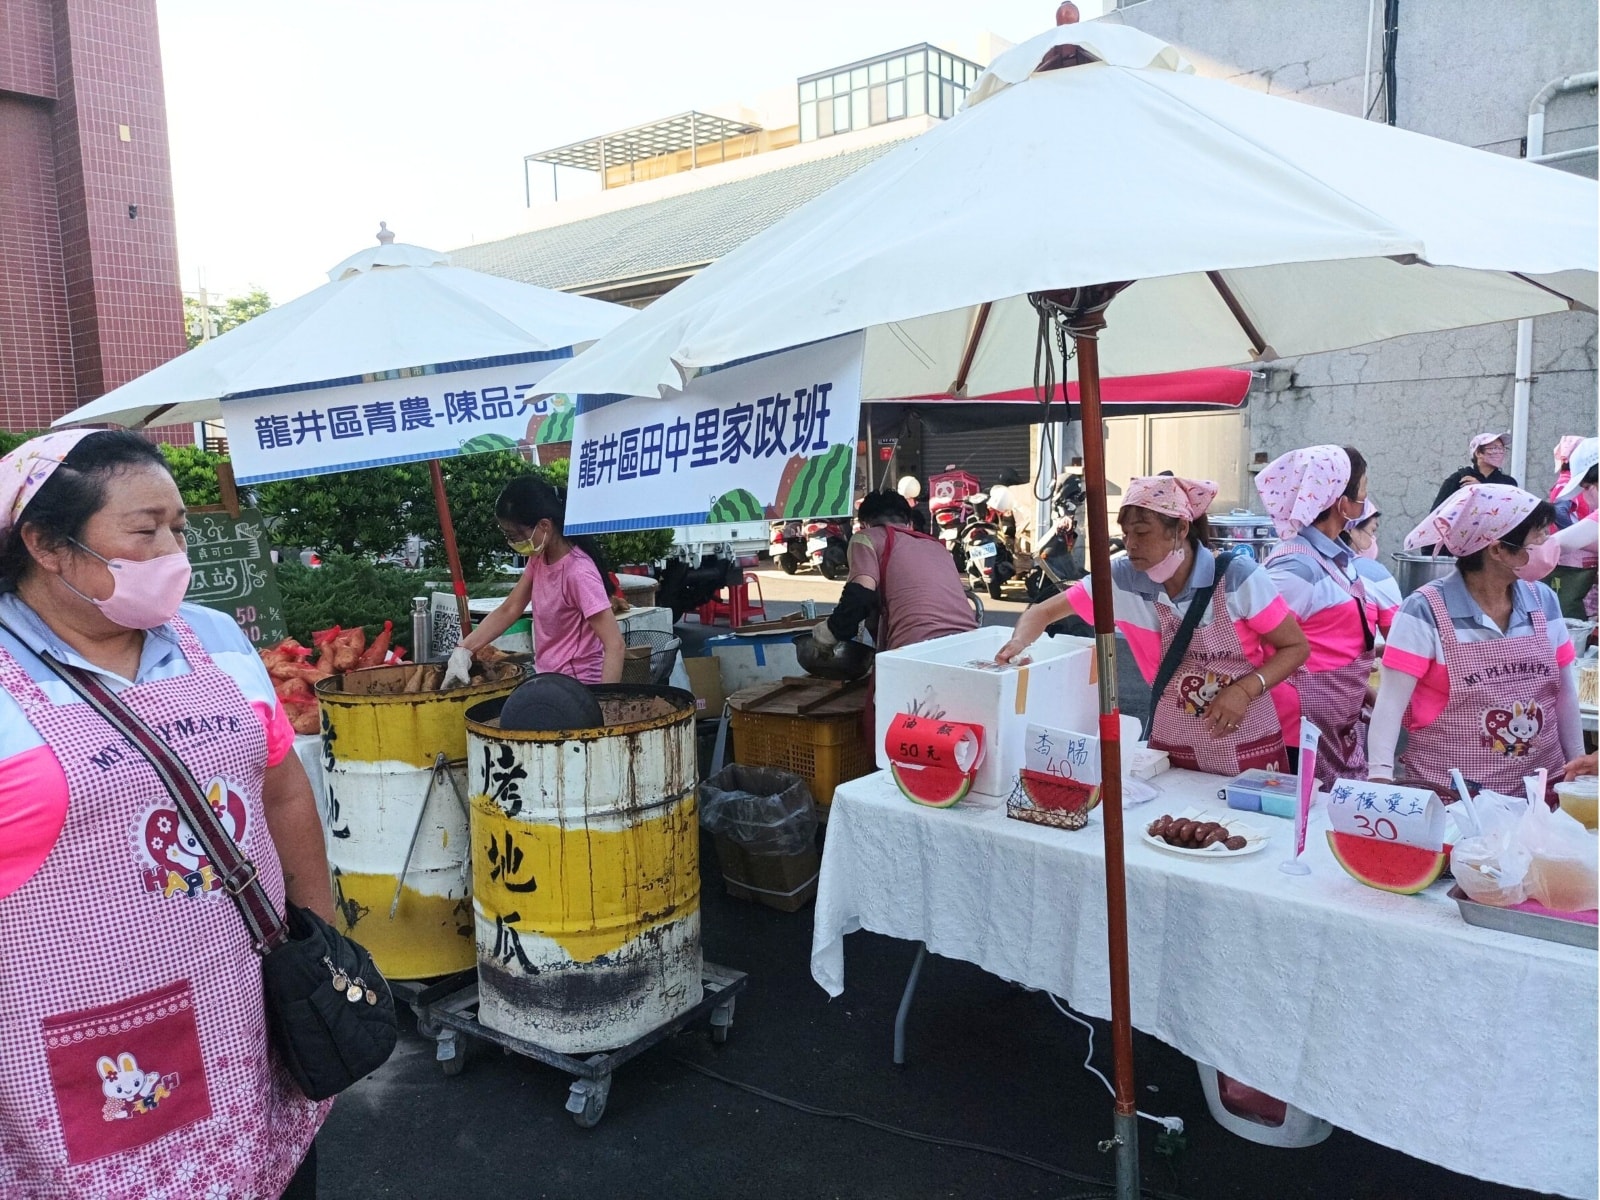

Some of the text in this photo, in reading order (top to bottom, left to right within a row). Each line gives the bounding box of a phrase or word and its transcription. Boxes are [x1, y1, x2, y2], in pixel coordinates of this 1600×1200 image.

[254, 383, 548, 450] 龍井區青農-陳品元
[577, 382, 833, 489] 龍井區田中里家政班
[235, 605, 257, 625] 50
[1463, 671, 1482, 687] MY
[1484, 663, 1551, 680] PLAYMATE
[902, 717, 953, 736] 油飯
[91, 742, 124, 773] MY
[1033, 729, 1089, 766] 香腸
[1046, 756, 1073, 780] 40
[1353, 814, 1398, 841] 30
[481, 744, 541, 975] 烤地瓜
